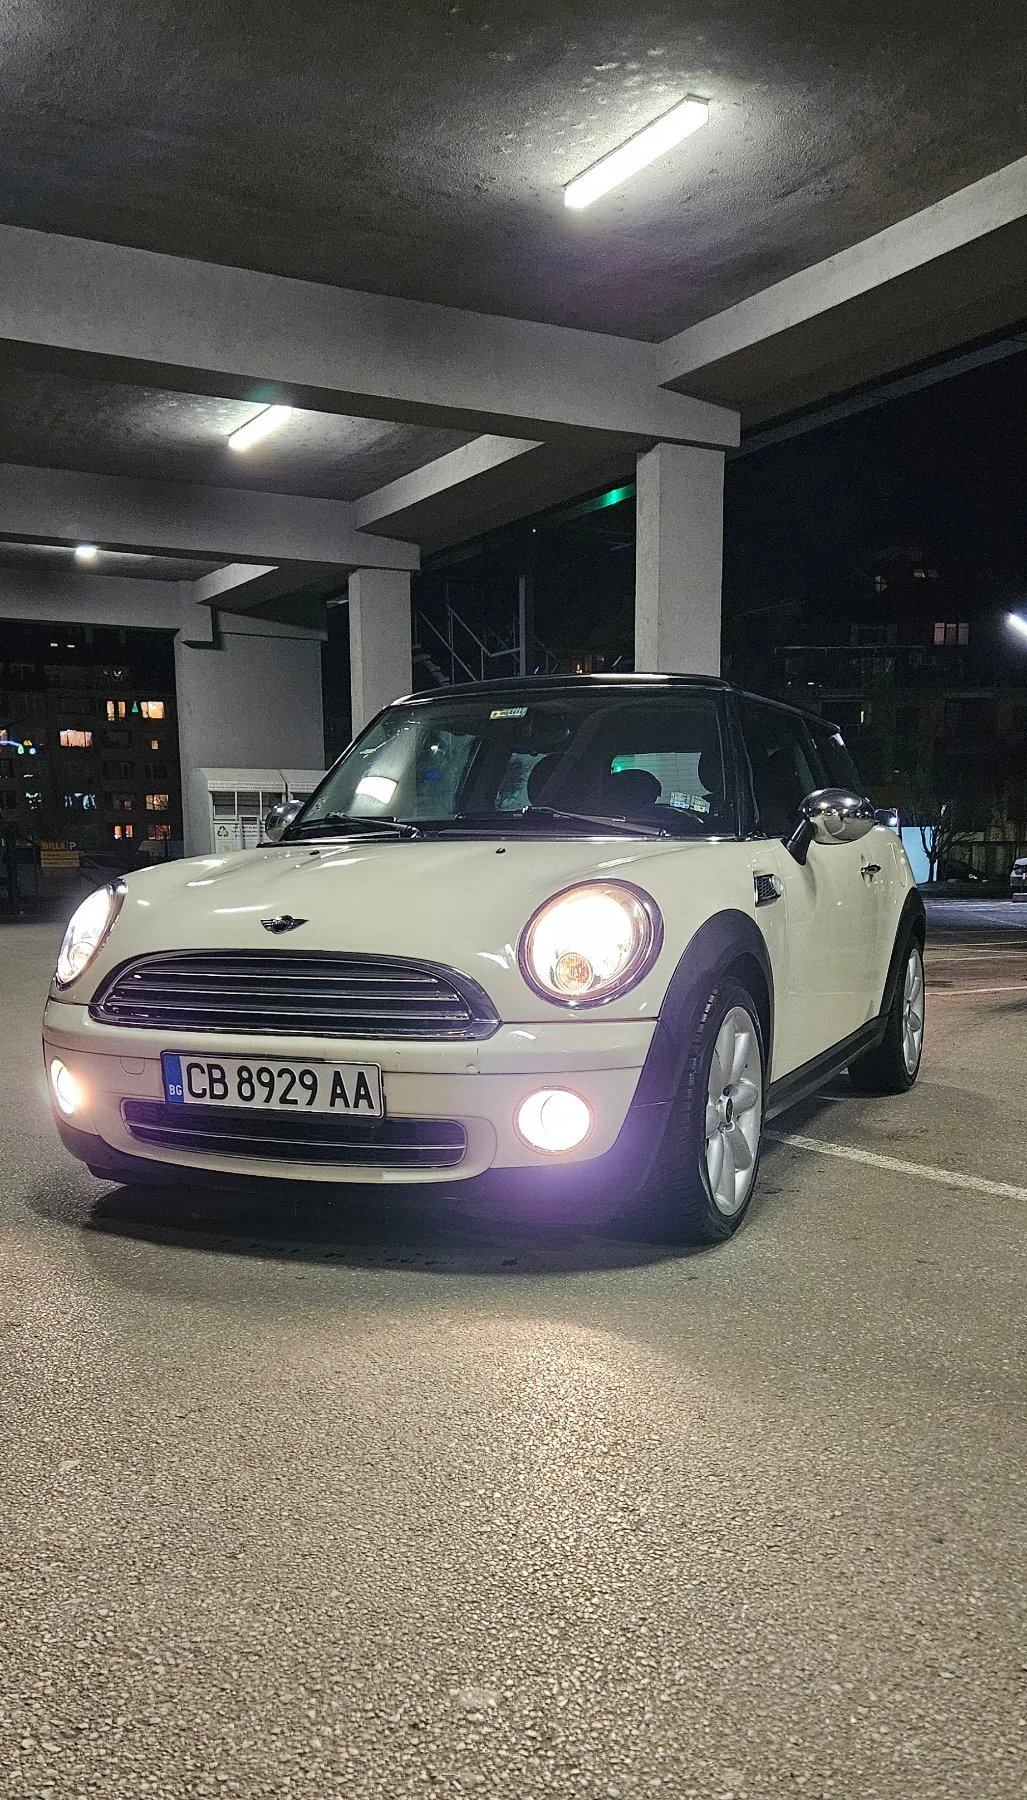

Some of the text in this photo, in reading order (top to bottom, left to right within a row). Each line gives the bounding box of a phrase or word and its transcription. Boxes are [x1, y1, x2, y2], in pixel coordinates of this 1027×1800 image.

[70, 842, 77, 850] P
[169, 1084, 182, 1096] BG
[186, 1062, 375, 1109] CB 8929 AA
